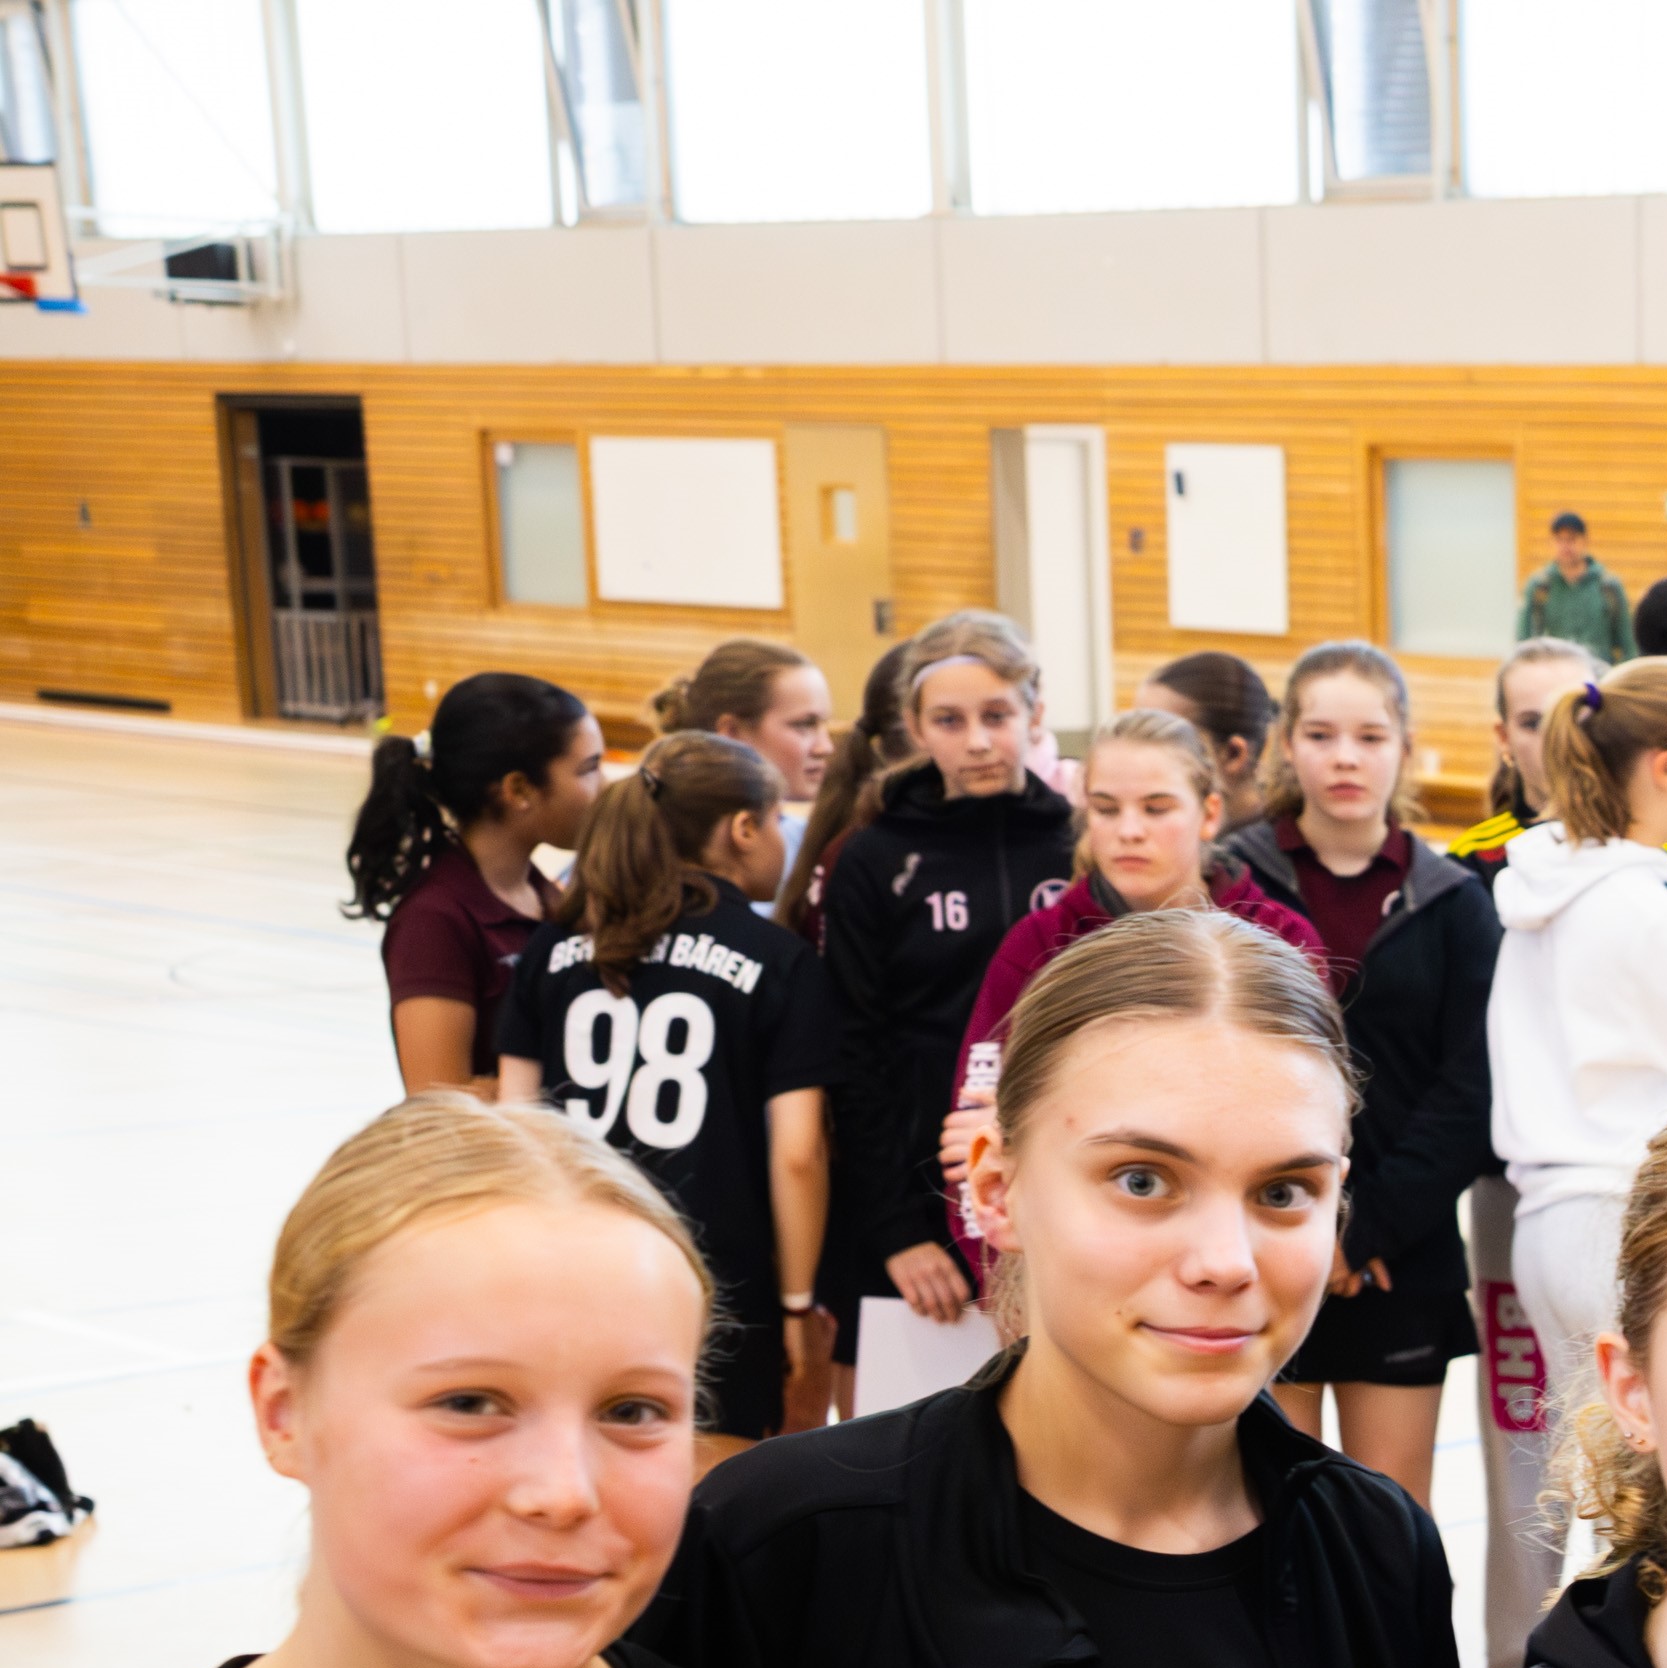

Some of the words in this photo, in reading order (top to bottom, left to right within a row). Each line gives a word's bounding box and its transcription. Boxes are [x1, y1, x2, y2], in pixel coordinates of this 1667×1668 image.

[925, 890, 970, 932] 16
[670, 933, 763, 995] BÄREN
[563, 989, 715, 1150] 98
